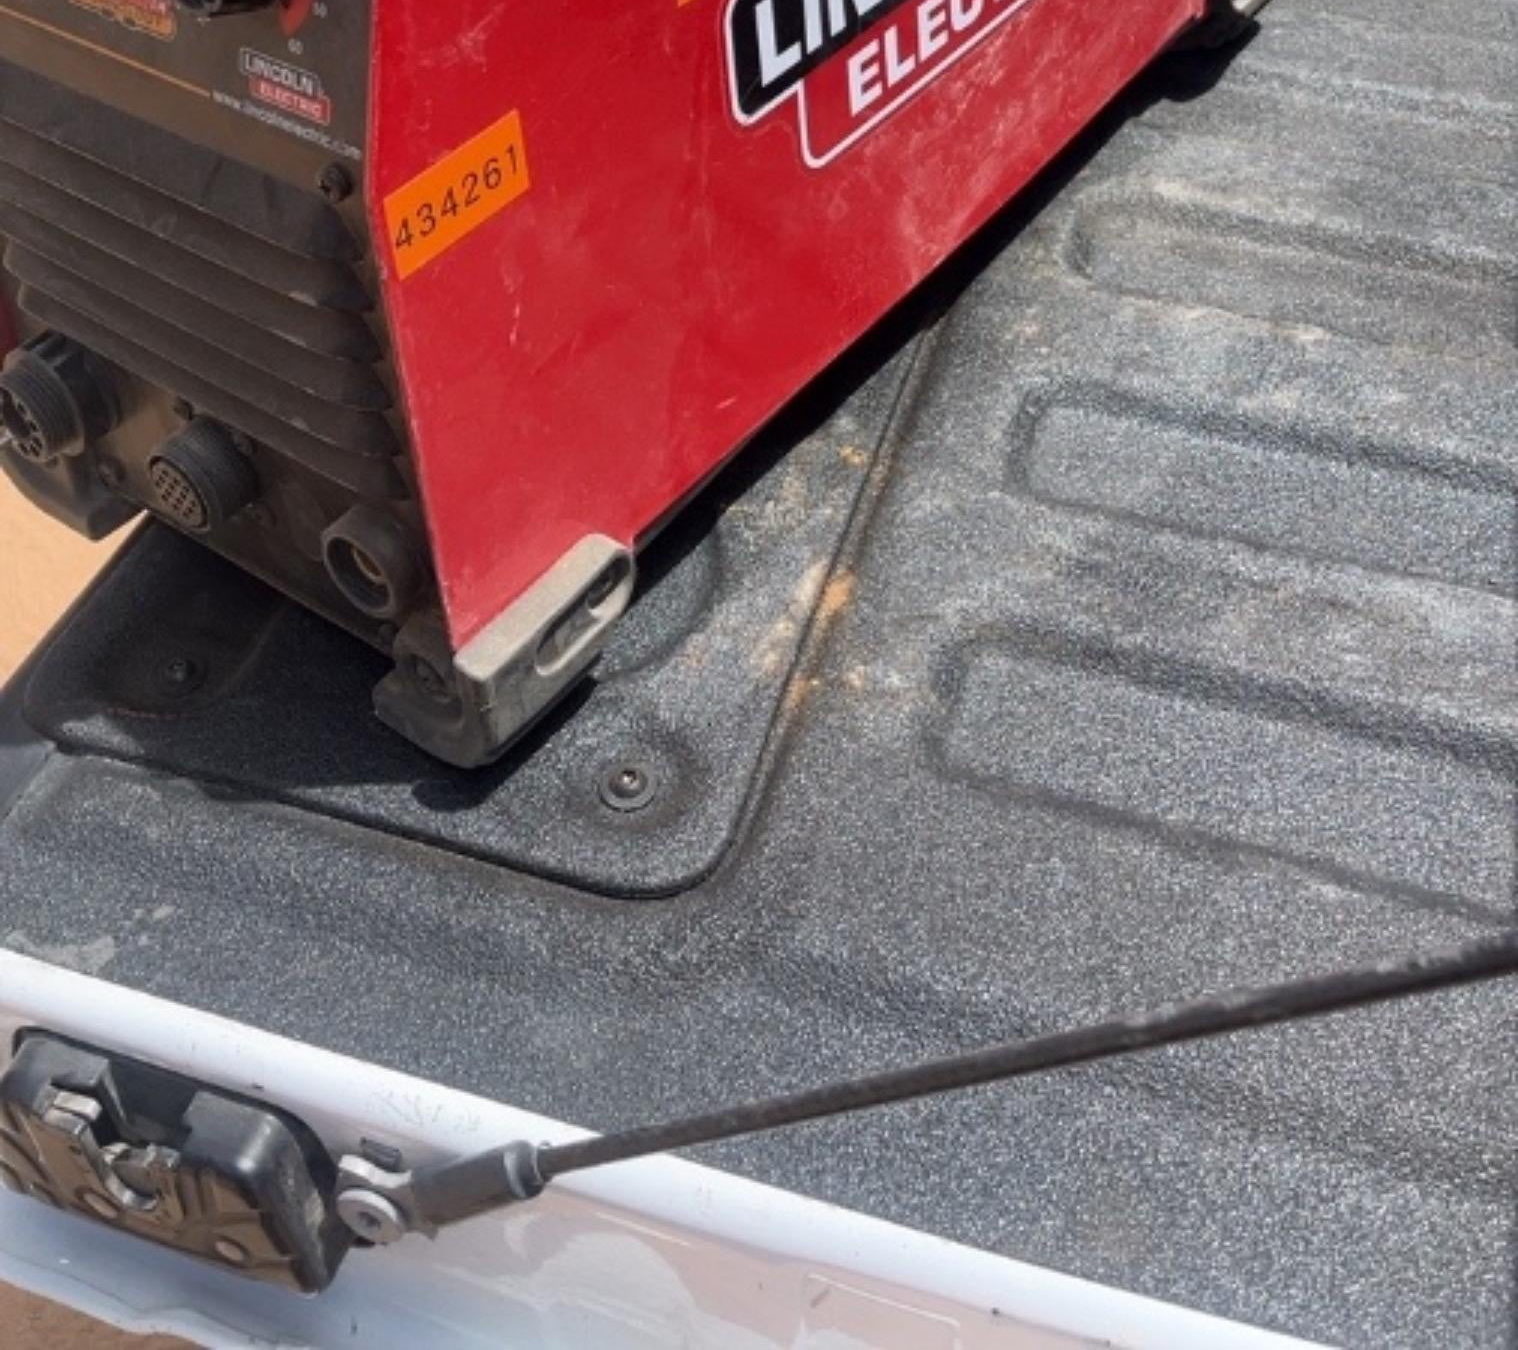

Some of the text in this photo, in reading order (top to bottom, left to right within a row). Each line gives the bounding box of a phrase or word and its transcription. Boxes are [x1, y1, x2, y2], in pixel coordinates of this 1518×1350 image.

[245, 51, 315, 96] LINCOLN
[259, 80, 323, 120] ELECTRIC
[395, 143, 518, 249] 434261
